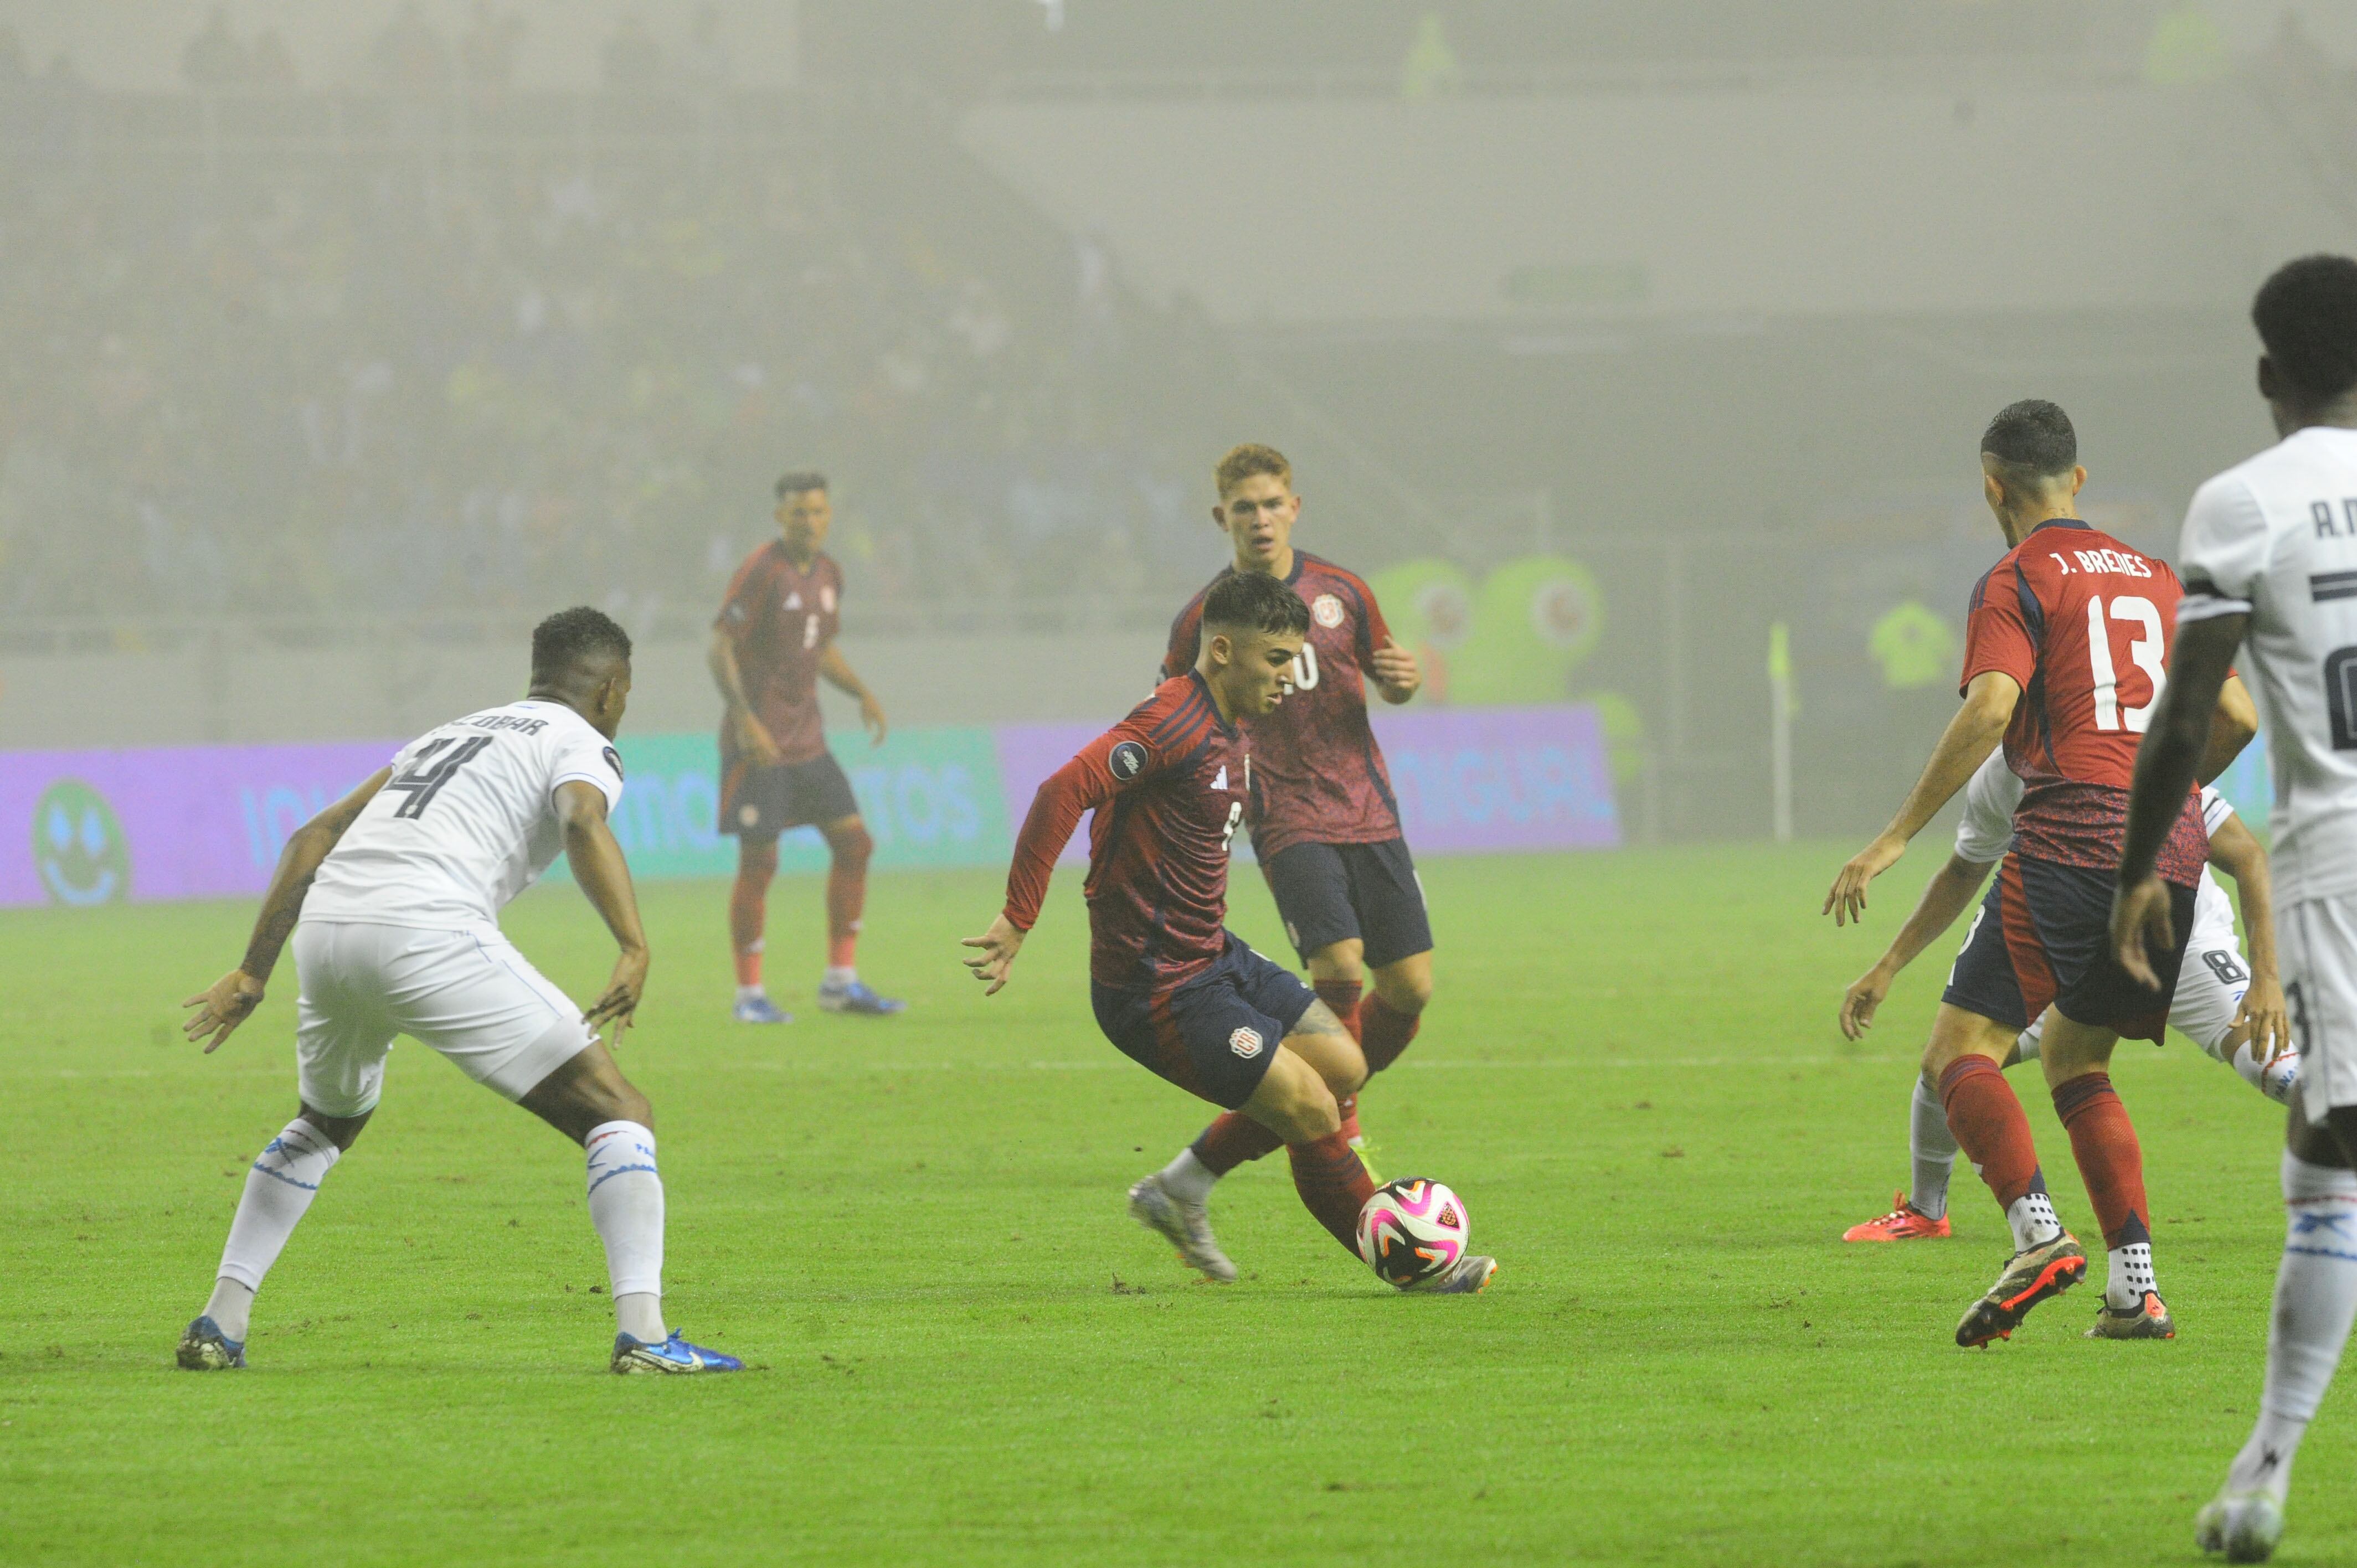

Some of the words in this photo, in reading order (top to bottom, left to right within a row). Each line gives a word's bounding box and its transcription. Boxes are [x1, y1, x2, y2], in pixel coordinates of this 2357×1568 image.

[2049, 553, 2077, 575] J.
[2073, 549, 2152, 578] BRENES
[1283, 642, 1319, 695] 0
[2087, 595, 2168, 734] 13
[383, 736, 495, 820] 4
[2201, 950, 2248, 985] 8
